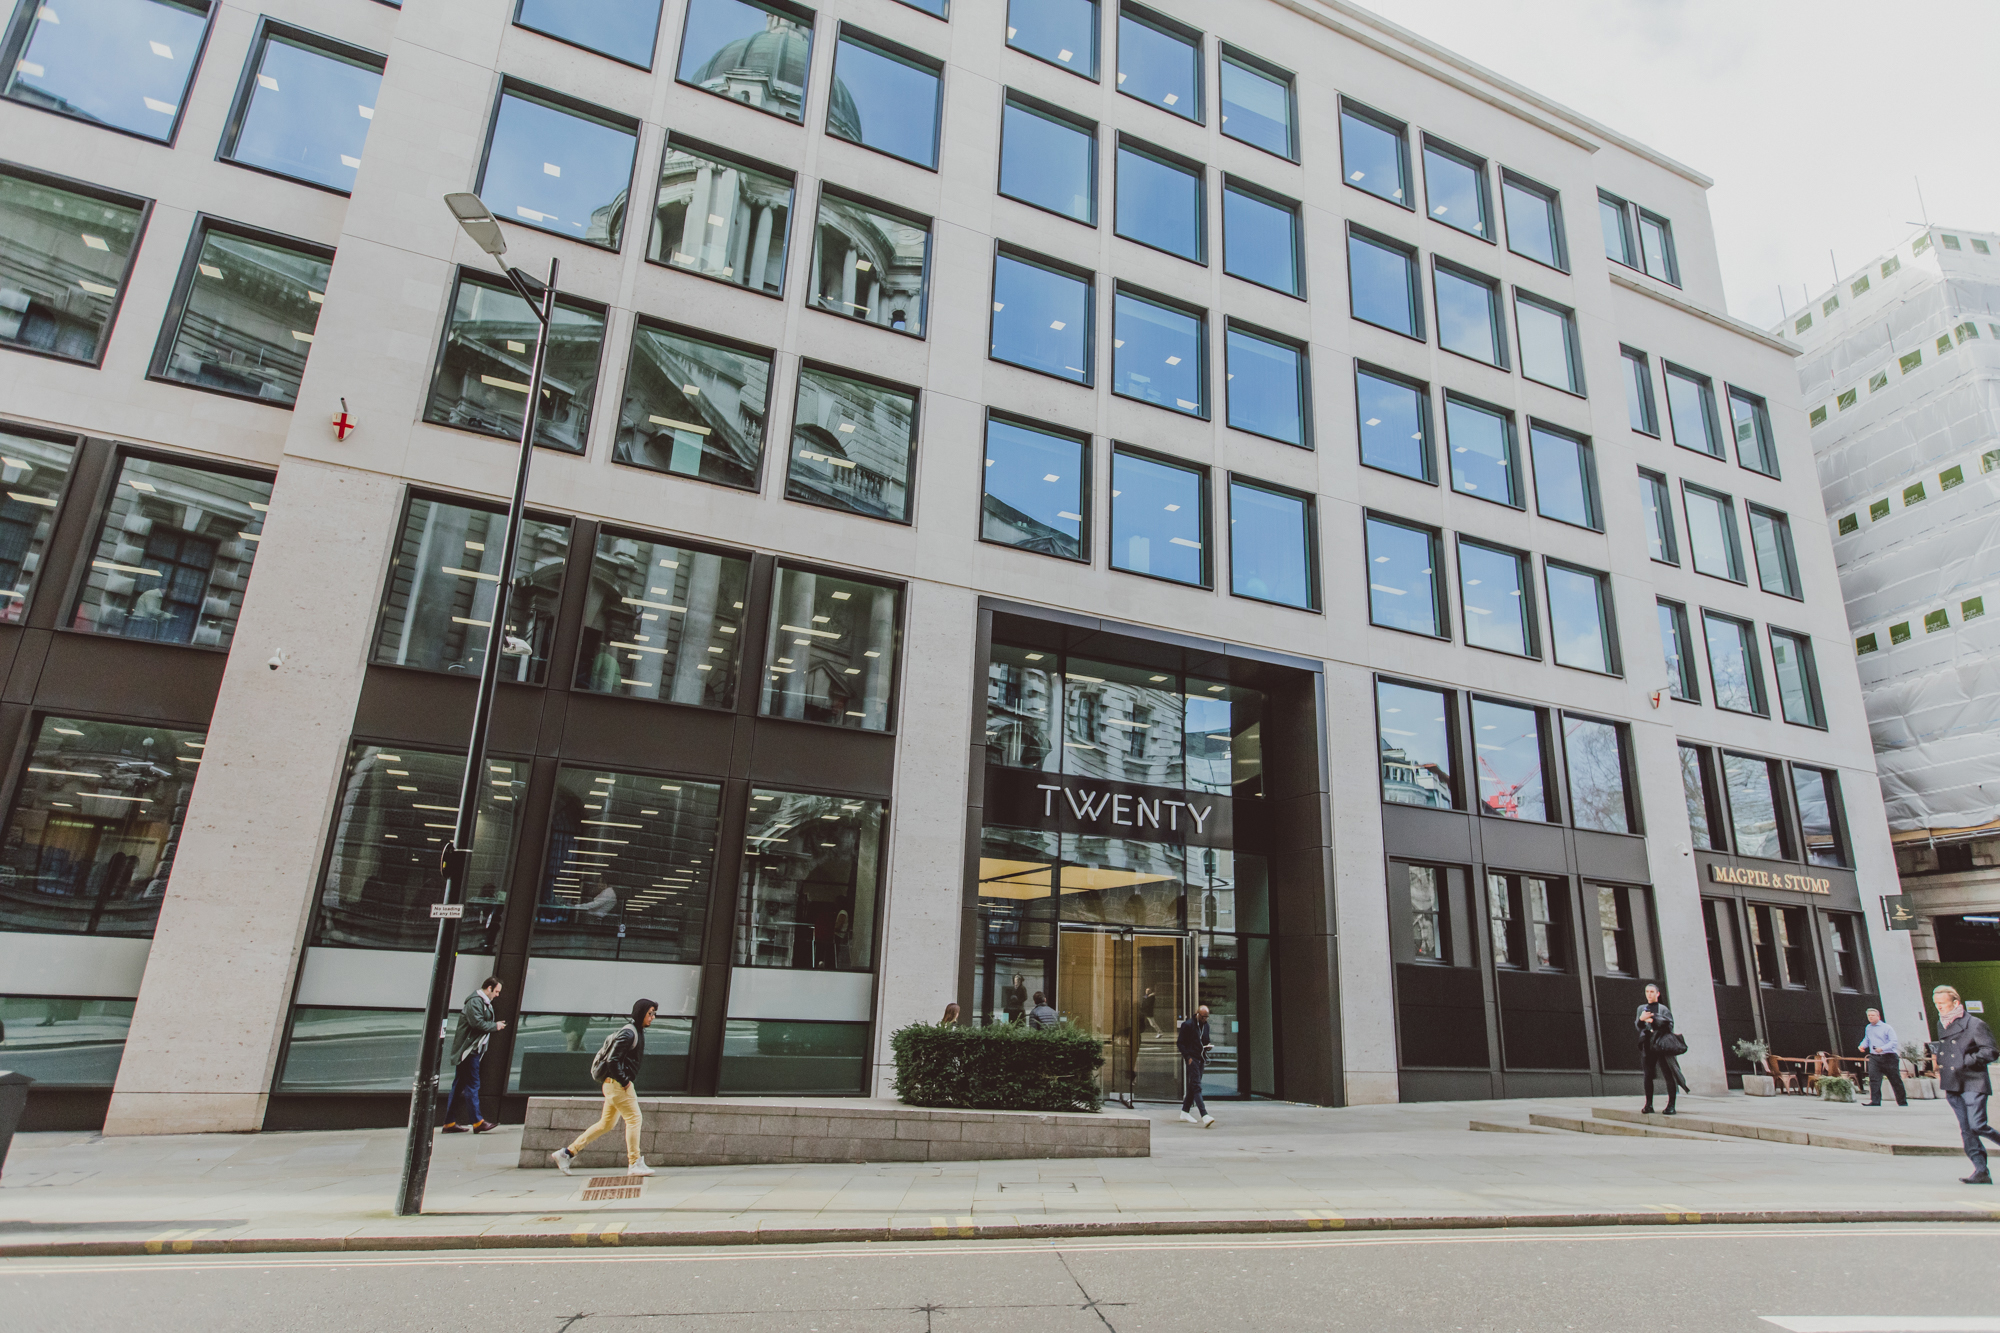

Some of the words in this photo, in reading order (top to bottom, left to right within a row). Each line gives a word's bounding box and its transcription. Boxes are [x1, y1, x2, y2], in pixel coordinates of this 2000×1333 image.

[1036, 784, 1212, 834] TWENTY
[1714, 866, 1770, 887] MAGPIE
[1772, 873, 1783, 888] &
[1784, 874, 1830, 894] STUMP
